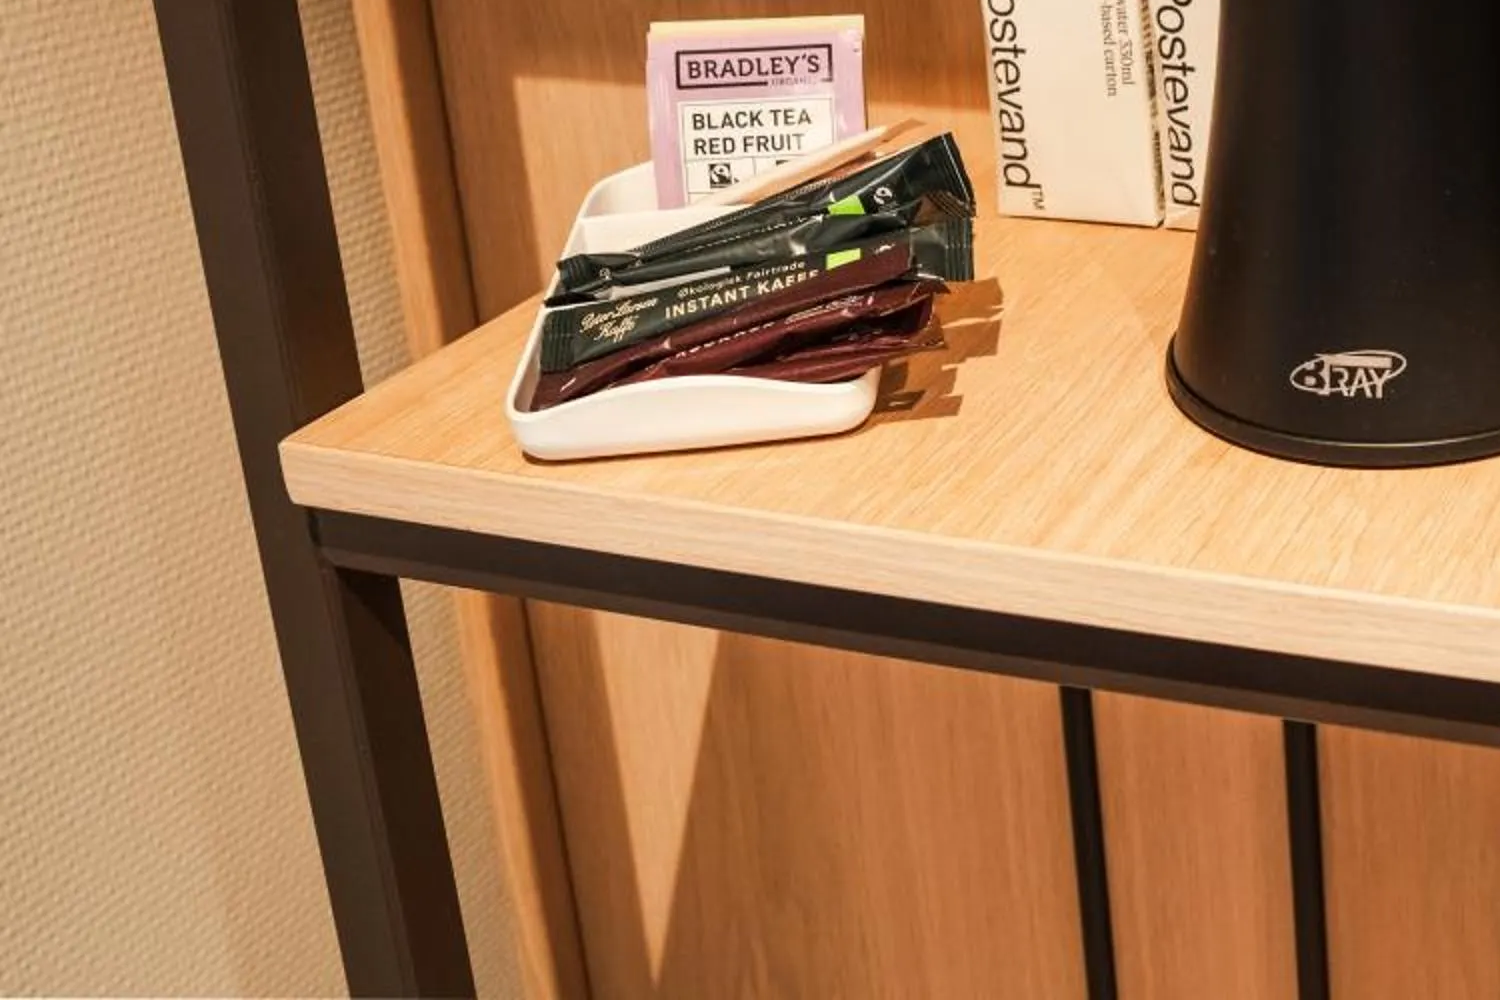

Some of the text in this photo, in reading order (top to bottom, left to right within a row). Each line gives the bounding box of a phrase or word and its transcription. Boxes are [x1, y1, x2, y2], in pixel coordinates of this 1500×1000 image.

[687, 54, 820, 80] BRADLEY'S
[1103, 49, 1119, 97] carton
[692, 109, 812, 131] BLACK TEA
[693, 133, 805, 156] RED FRUIT
[664, 284, 751, 320] INSTANT
